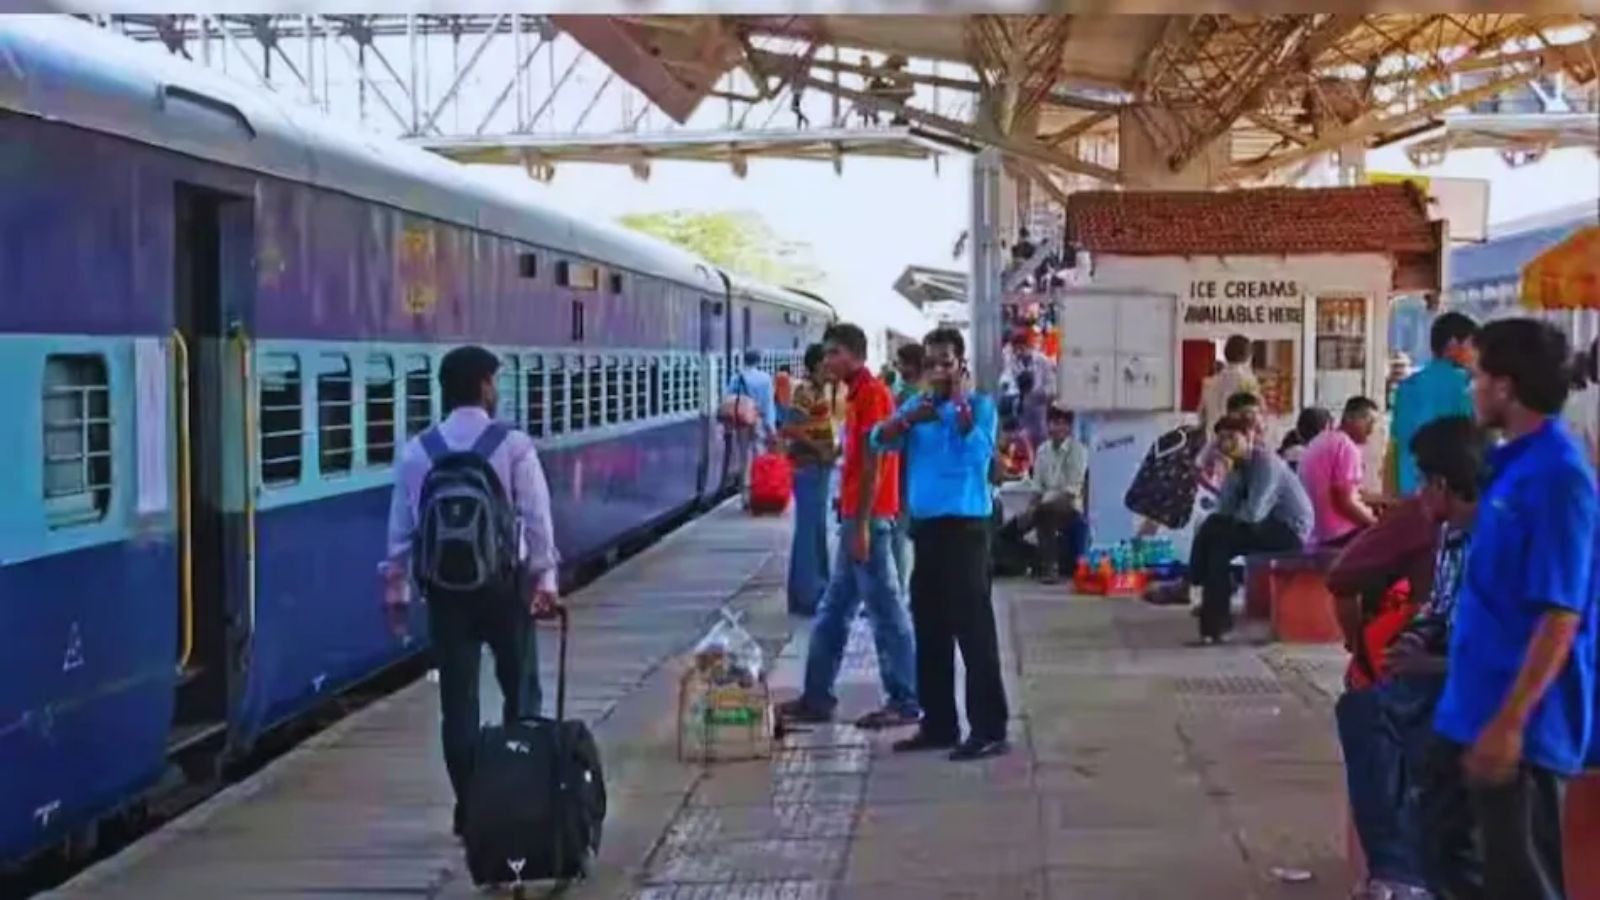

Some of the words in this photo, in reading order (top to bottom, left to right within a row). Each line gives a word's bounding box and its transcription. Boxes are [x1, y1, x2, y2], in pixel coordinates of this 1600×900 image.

[1190, 281, 1216, 298] ICE
[1224, 281, 1298, 298] CREAMS
[1184, 304, 1265, 323] AVAILABLE
